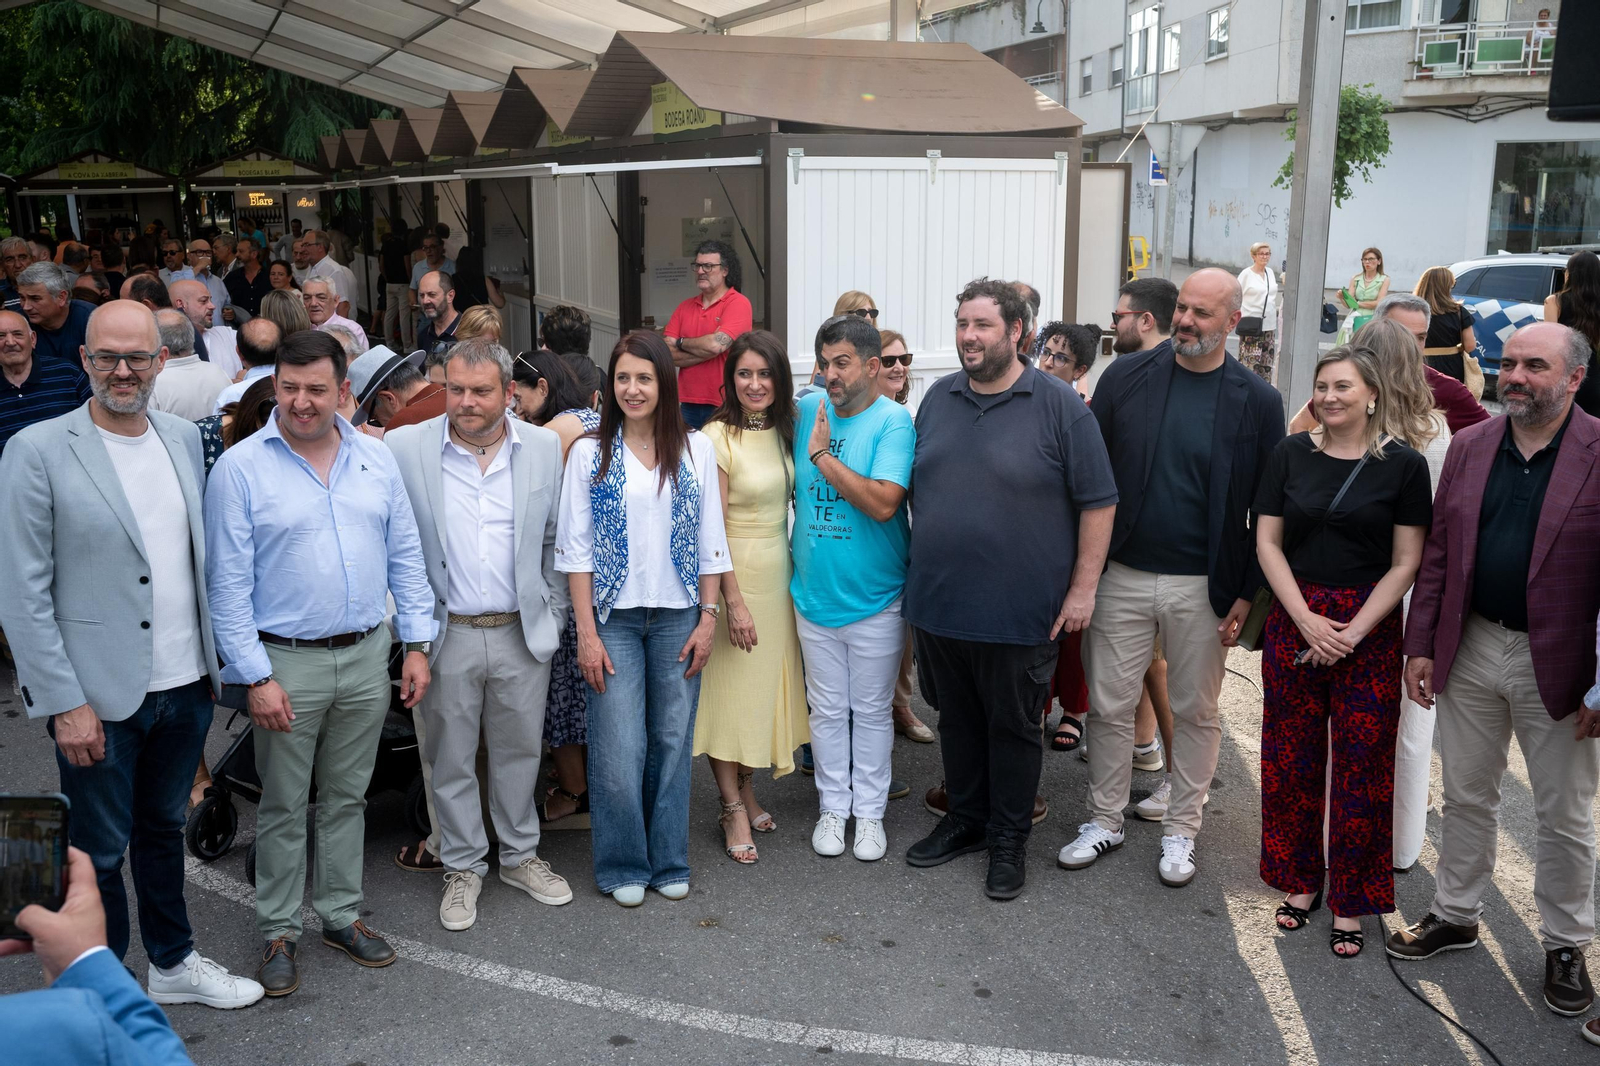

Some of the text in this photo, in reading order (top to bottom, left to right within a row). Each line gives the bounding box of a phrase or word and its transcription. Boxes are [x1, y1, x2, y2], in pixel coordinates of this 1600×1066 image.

[664, 110, 686, 128] BODEGA
[250, 195, 274, 206] Blare
[814, 505, 834, 522] TE
[808, 523, 853, 533] VALDEORRAS
